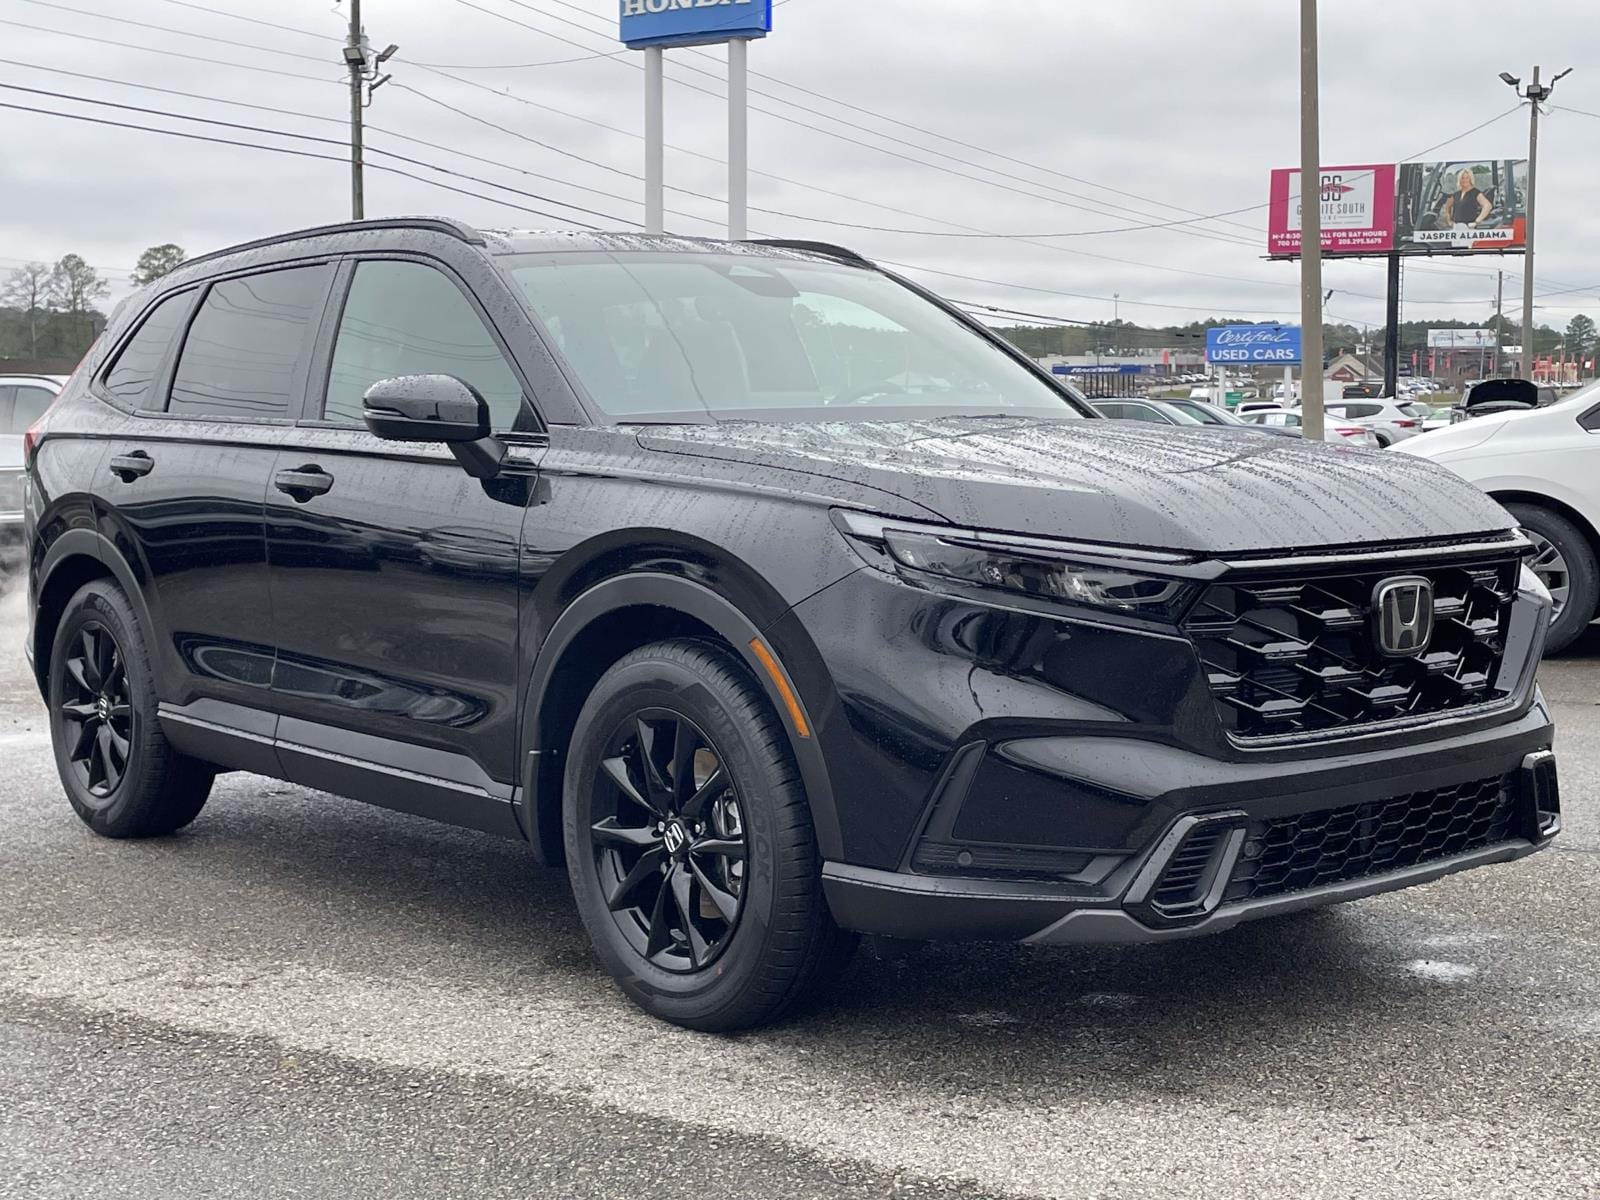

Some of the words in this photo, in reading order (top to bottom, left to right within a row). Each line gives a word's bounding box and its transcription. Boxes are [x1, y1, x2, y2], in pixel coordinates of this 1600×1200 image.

[1297, 203, 1334, 215] GITE
[1337, 203, 1365, 214] SOUTH
[1420, 231, 1457, 240] JASPER
[1460, 231, 1507, 239] ALABAMA
[1216, 329, 1290, 347] Certified
[1212, 349, 1249, 360] USED
[1253, 348, 1294, 360] CARS
